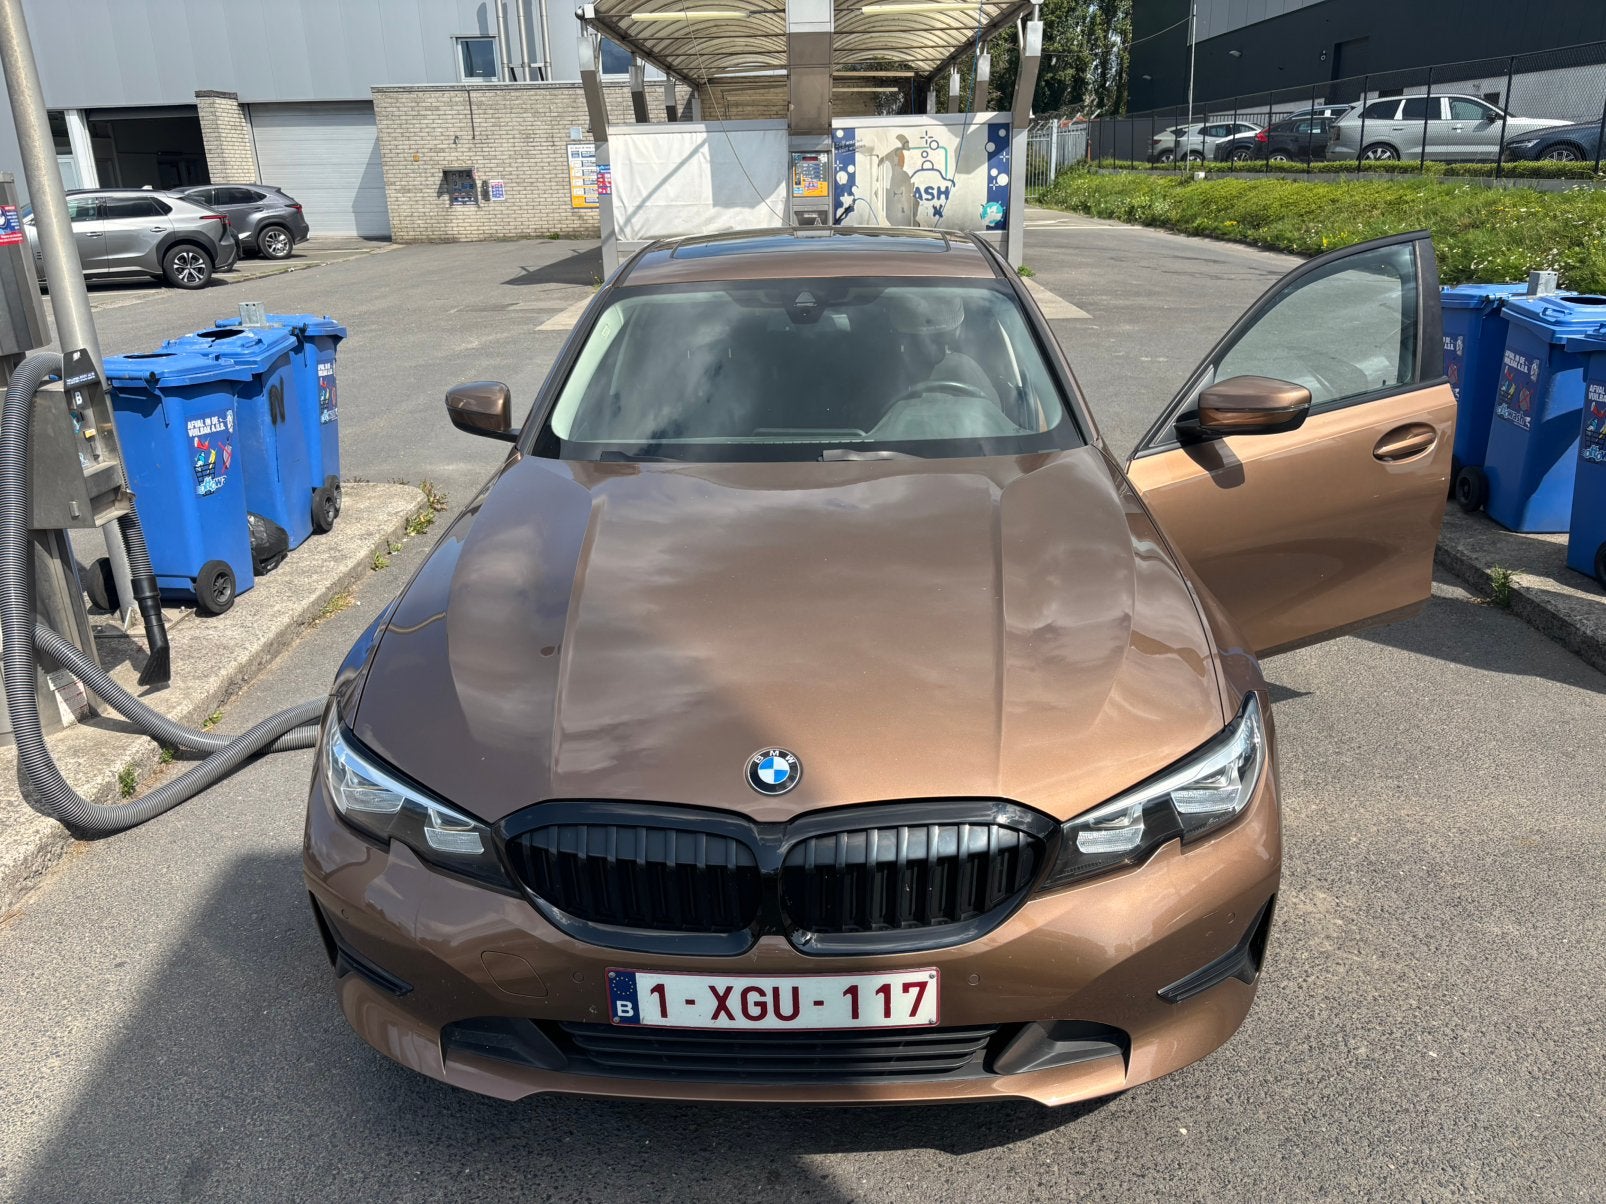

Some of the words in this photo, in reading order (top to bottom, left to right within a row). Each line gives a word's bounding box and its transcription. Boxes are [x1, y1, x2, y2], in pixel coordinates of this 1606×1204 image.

[1589, 384, 1605, 395] AFVAL
[75, 391, 83, 405] B
[188, 419, 205, 429] AFVAL
[188, 425, 212, 437] VUILBAK
[754, 750, 796, 764] BMW
[616, 1000, 634, 1018] B
